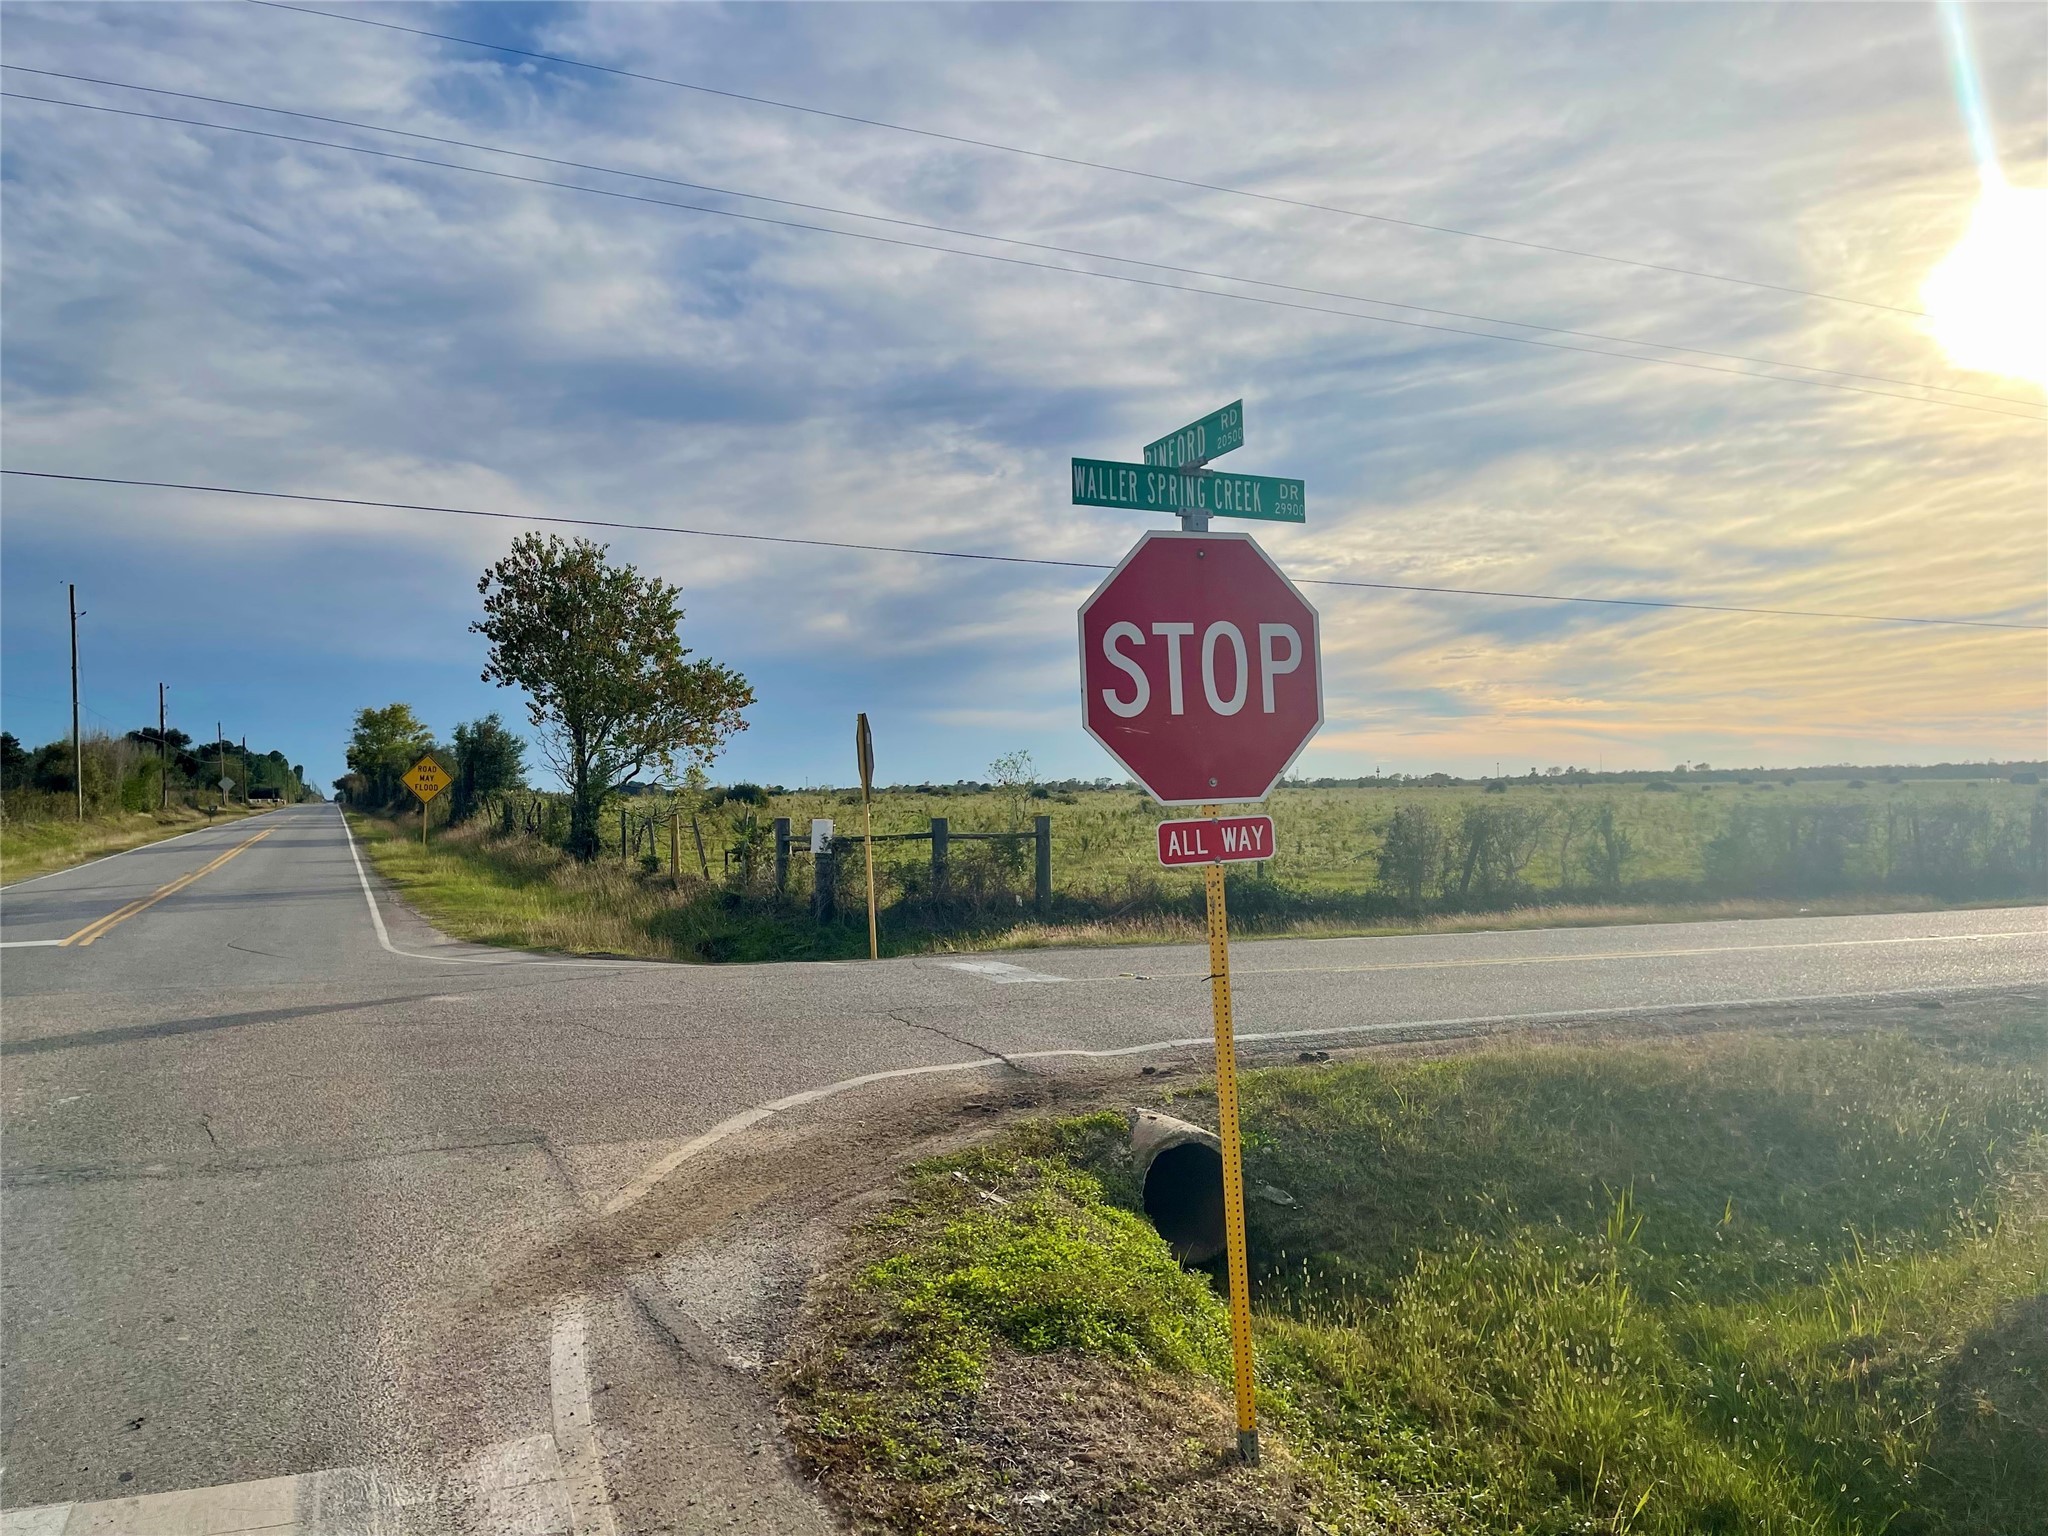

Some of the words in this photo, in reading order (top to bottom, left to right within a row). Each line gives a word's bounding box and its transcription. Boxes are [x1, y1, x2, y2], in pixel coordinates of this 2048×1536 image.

[1221, 409, 1238, 430] RD
[1217, 427, 1242, 449] 20500
[1074, 465, 1137, 502] WALLER
[1147, 472, 1205, 508] SPRING
[1214, 478, 1262, 512] CREEK
[1280, 483, 1298, 500] DR
[1275, 502, 1304, 516] 29900
[1102, 620, 1302, 718] STOP
[1168, 830, 1208, 857] ALL
[1221, 825, 1263, 853] WAY
